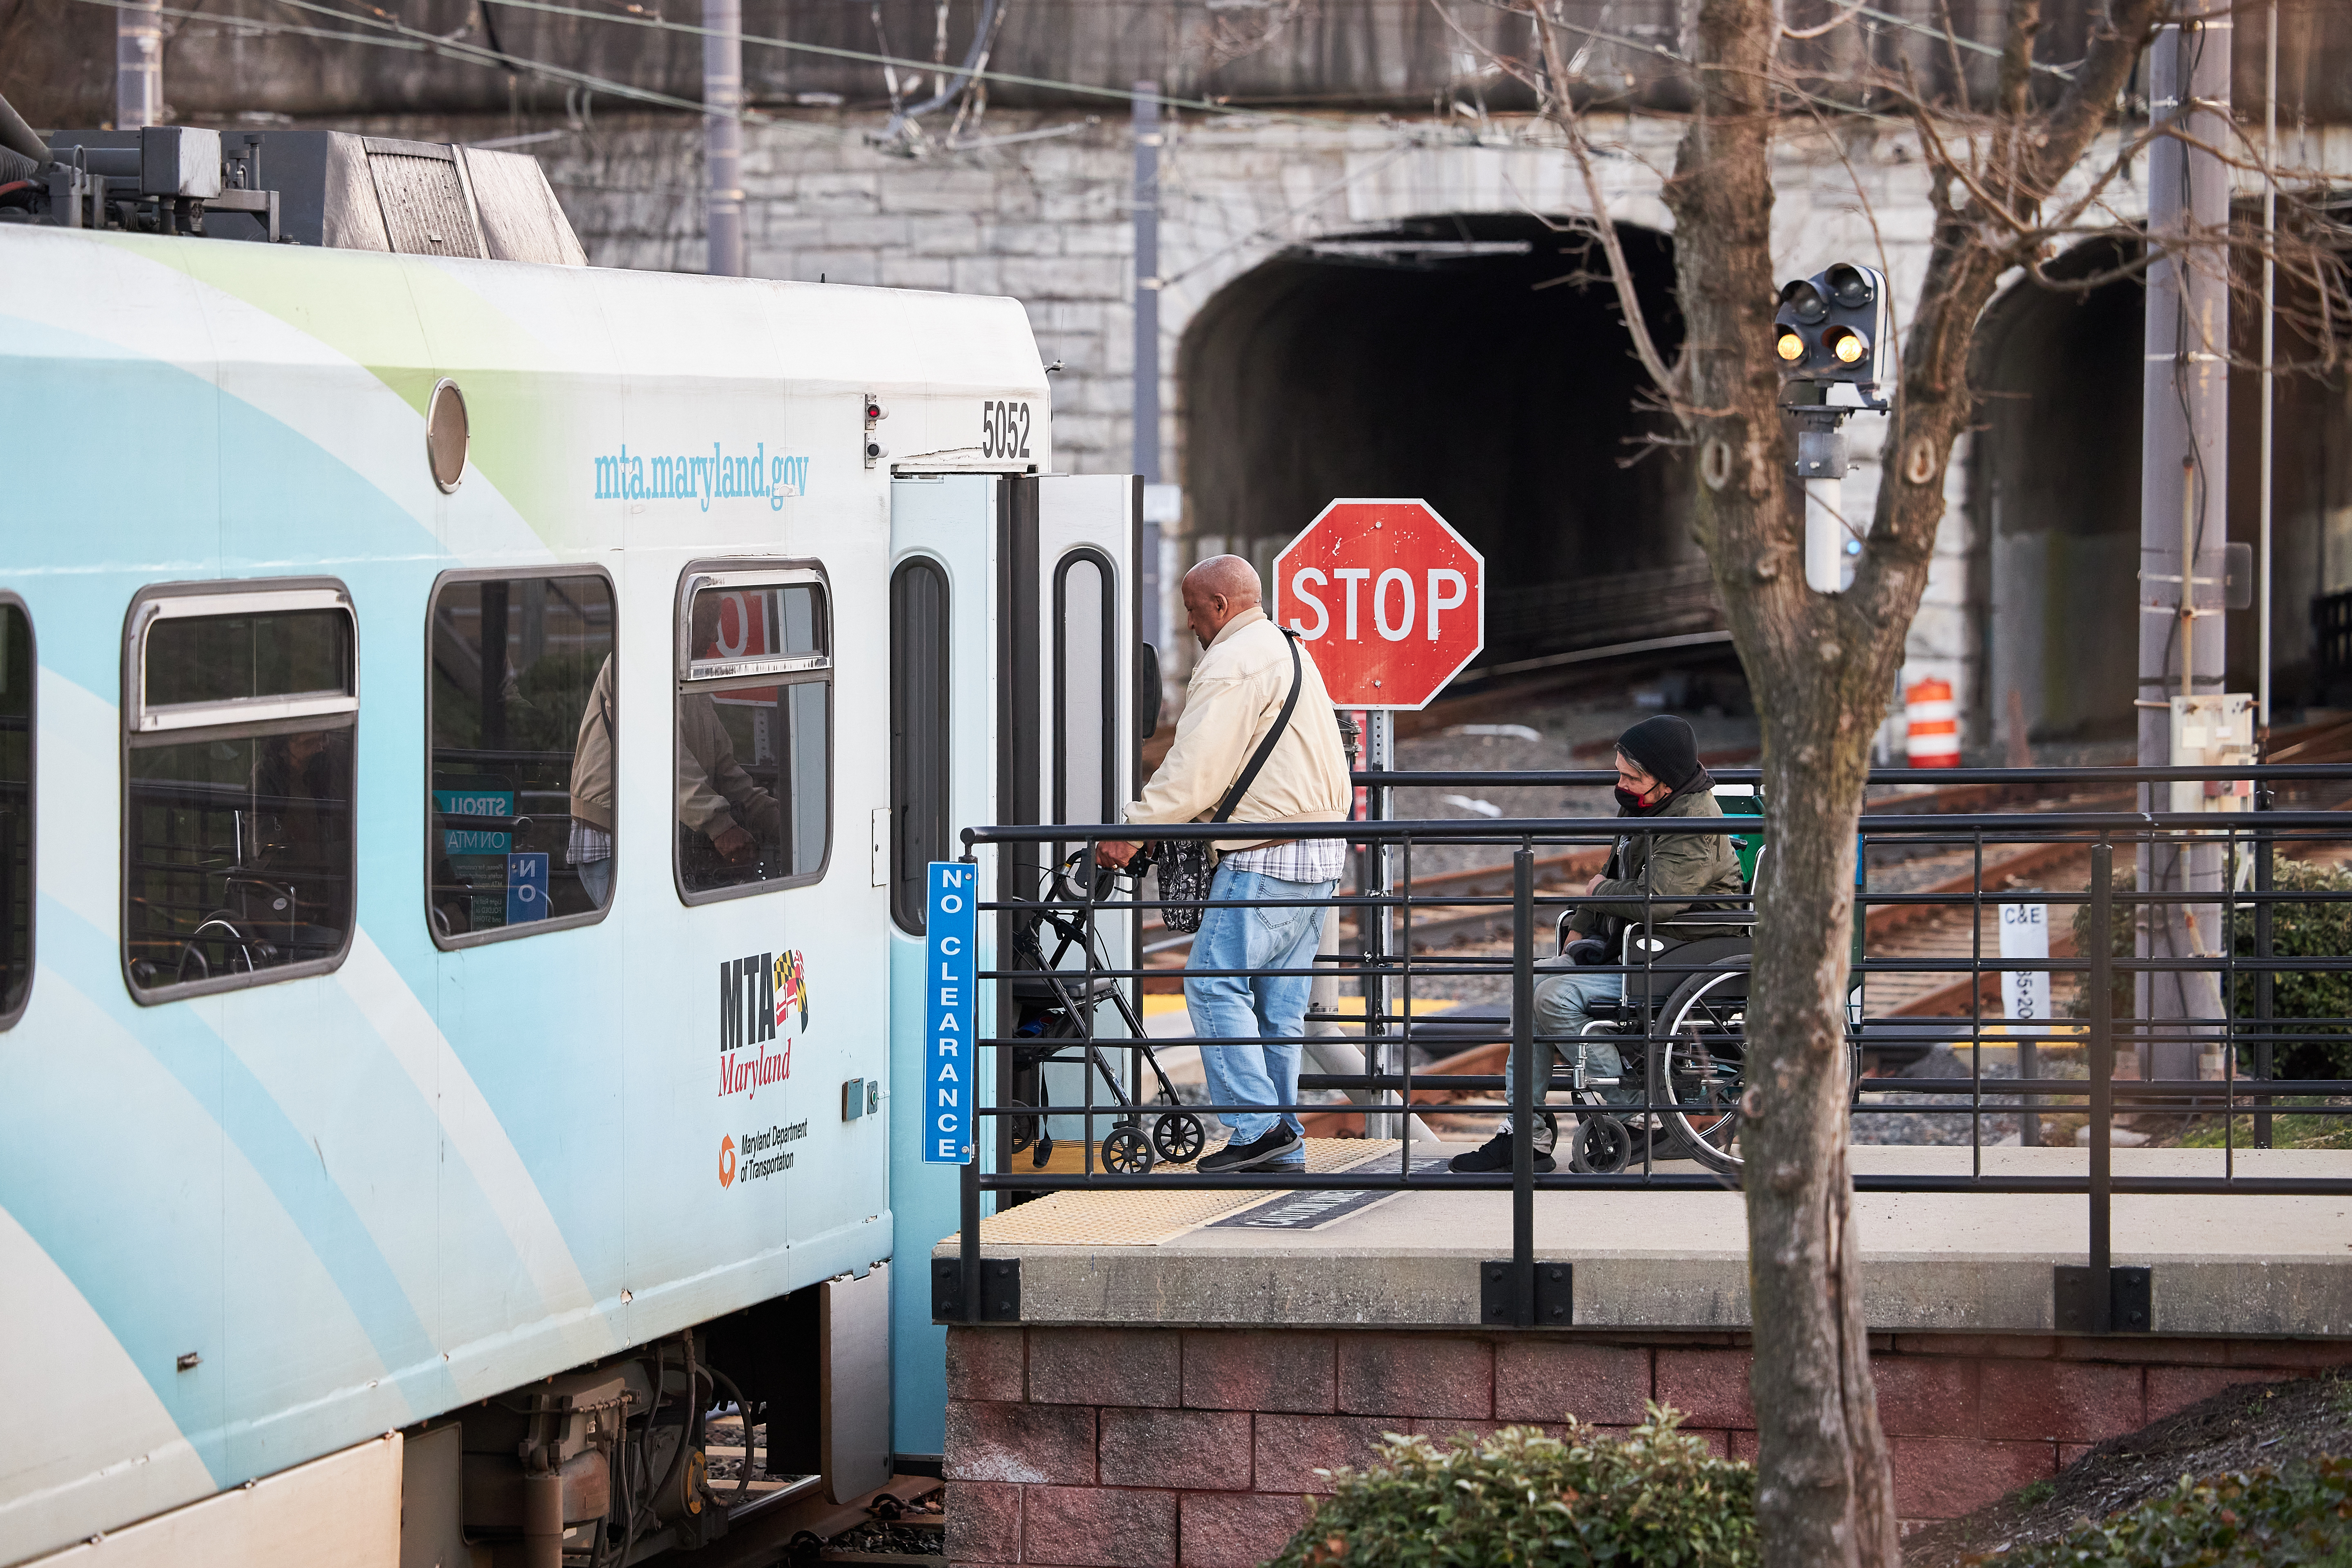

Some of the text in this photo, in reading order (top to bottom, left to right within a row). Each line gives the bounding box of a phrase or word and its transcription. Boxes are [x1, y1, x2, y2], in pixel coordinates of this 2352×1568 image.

[983, 401, 1030, 459] 5052
[594, 442, 809, 512] mta.maryland.gov
[1289, 567, 1467, 641] STOP
[941, 869, 962, 913] NO
[2005, 907, 2040, 924] C&E
[720, 952, 776, 1052] MTA
[718, 1037, 791, 1100] Maryland
[938, 937, 961, 1157] CLEARANCE
[741, 1118, 807, 1158] Maryland Department
[741, 1151, 794, 1183] of Transportation
[1244, 1203, 1339, 1226] CAUTION
